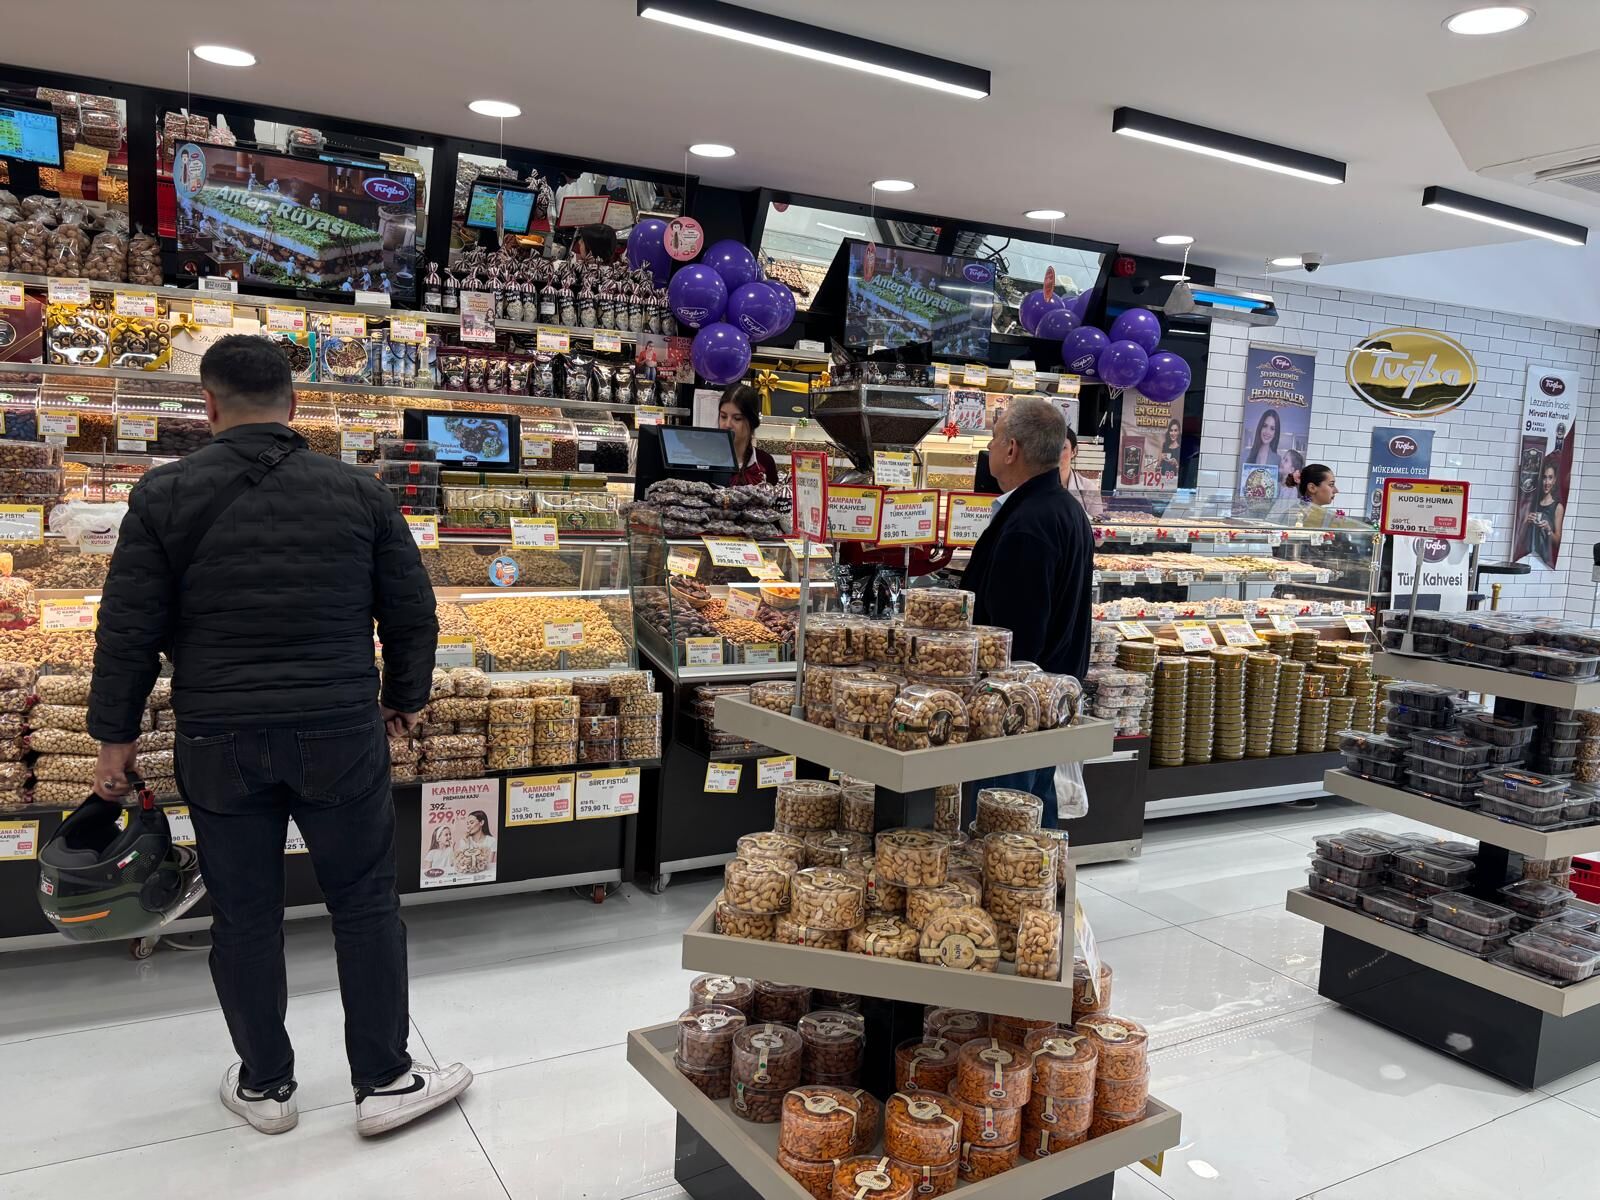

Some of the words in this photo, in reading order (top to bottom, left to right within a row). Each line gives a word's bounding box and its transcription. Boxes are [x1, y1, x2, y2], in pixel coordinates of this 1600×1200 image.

[215, 185, 270, 214] Antep
[873, 273, 905, 295] Antep
[1370, 351, 1462, 399] Tuğba
[1263, 380, 1273, 388] EN
[1273, 380, 1296, 391] GÜZEL
[1251, 388, 1305, 405] HEDİYELİKLER
[1135, 407, 1145, 415] EN
[1146, 407, 1171, 417] GÜZEL
[1525, 420, 1533, 432] 9
[1394, 440, 1415, 454] Tuğba
[1371, 464, 1409, 475] MÜKEMMEL
[1398, 495, 1425, 503] KUDÜS
[1425, 497, 1454, 505] HURMA
[839, 504, 867, 512] KAHVESİ
[904, 509, 927, 517] KAHVESİ
[1397, 572, 1420, 586] Tür
[1422, 572, 1463, 586] Kahvesi
[431, 784, 490, 796] KAMPANYA
[522, 784, 561, 793] KAMPANYA
